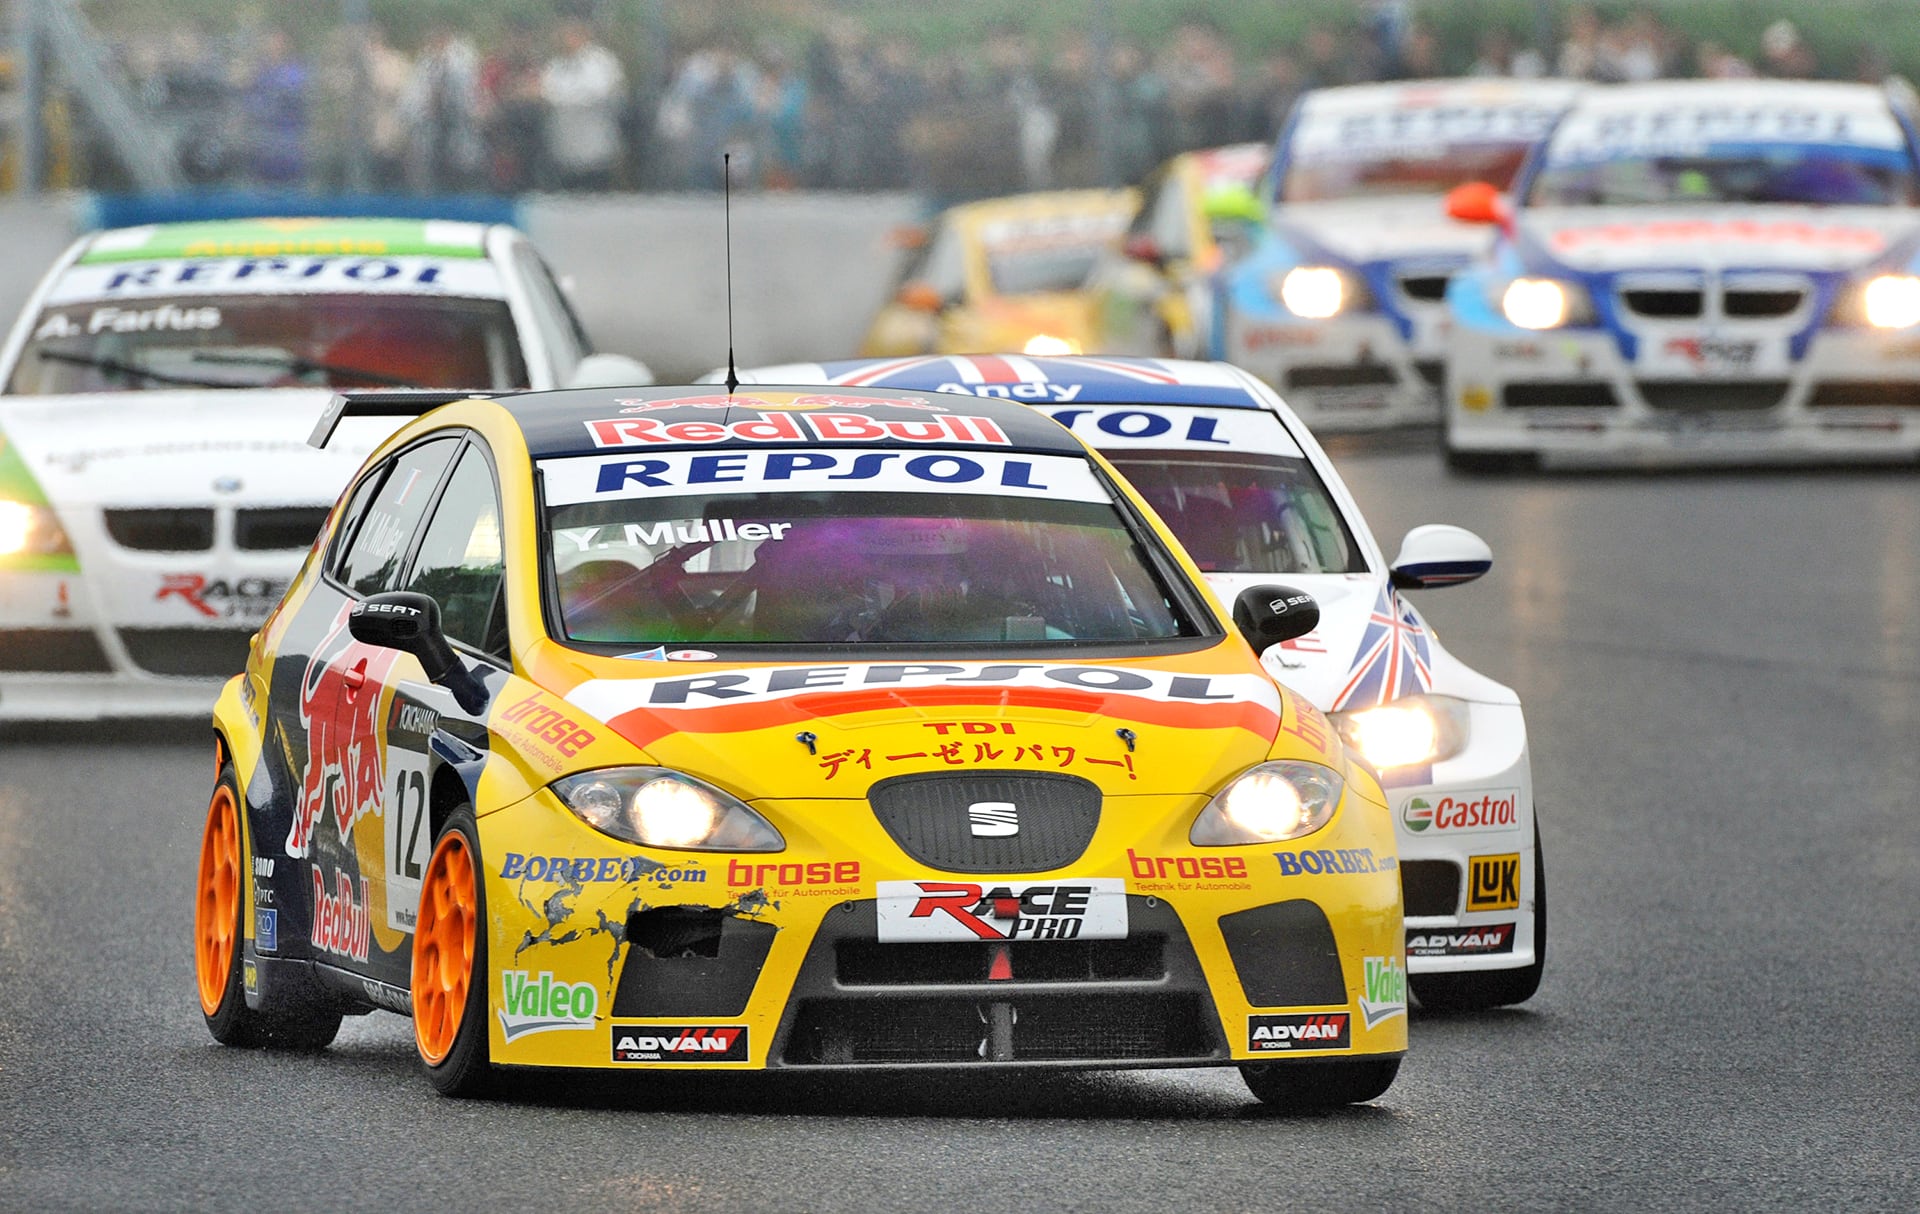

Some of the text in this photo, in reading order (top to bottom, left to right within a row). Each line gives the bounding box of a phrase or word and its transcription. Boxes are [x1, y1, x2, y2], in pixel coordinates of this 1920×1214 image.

[106, 257, 444, 290] REPSOL
[88, 305, 223, 333] Farfus
[935, 381, 1083, 402] Andy
[592, 412, 1010, 447] Red Bull
[1050, 410, 1230, 444] SOL
[594, 453, 1048, 493] REPSOL
[560, 518, 793, 552] Y. Muller
[367, 603, 422, 617] SEAT
[1286, 595, 1316, 606] SEA
[648, 664, 1235, 705] REPSOL
[500, 691, 597, 758] brose
[922, 722, 1017, 735] TDI
[395, 769, 425, 880] 12
[1435, 793, 1517, 830] Castrol
[727, 858, 861, 887] brose
[1126, 848, 1248, 880] brose
[773, 888, 789, 899] für
[792, 886, 861, 898] Automobile
[1134, 881, 1252, 892] Technik für Automobile
[312, 864, 371, 964] Red Bull
[909, 882, 1092, 940] RACE
[1007, 917, 1084, 940] PRO
[1406, 932, 1502, 948] ADVAN
[504, 973, 595, 1019] Valeo
[615, 1036, 728, 1051] ADVAN
[1251, 1024, 1339, 1040] ADVAN
